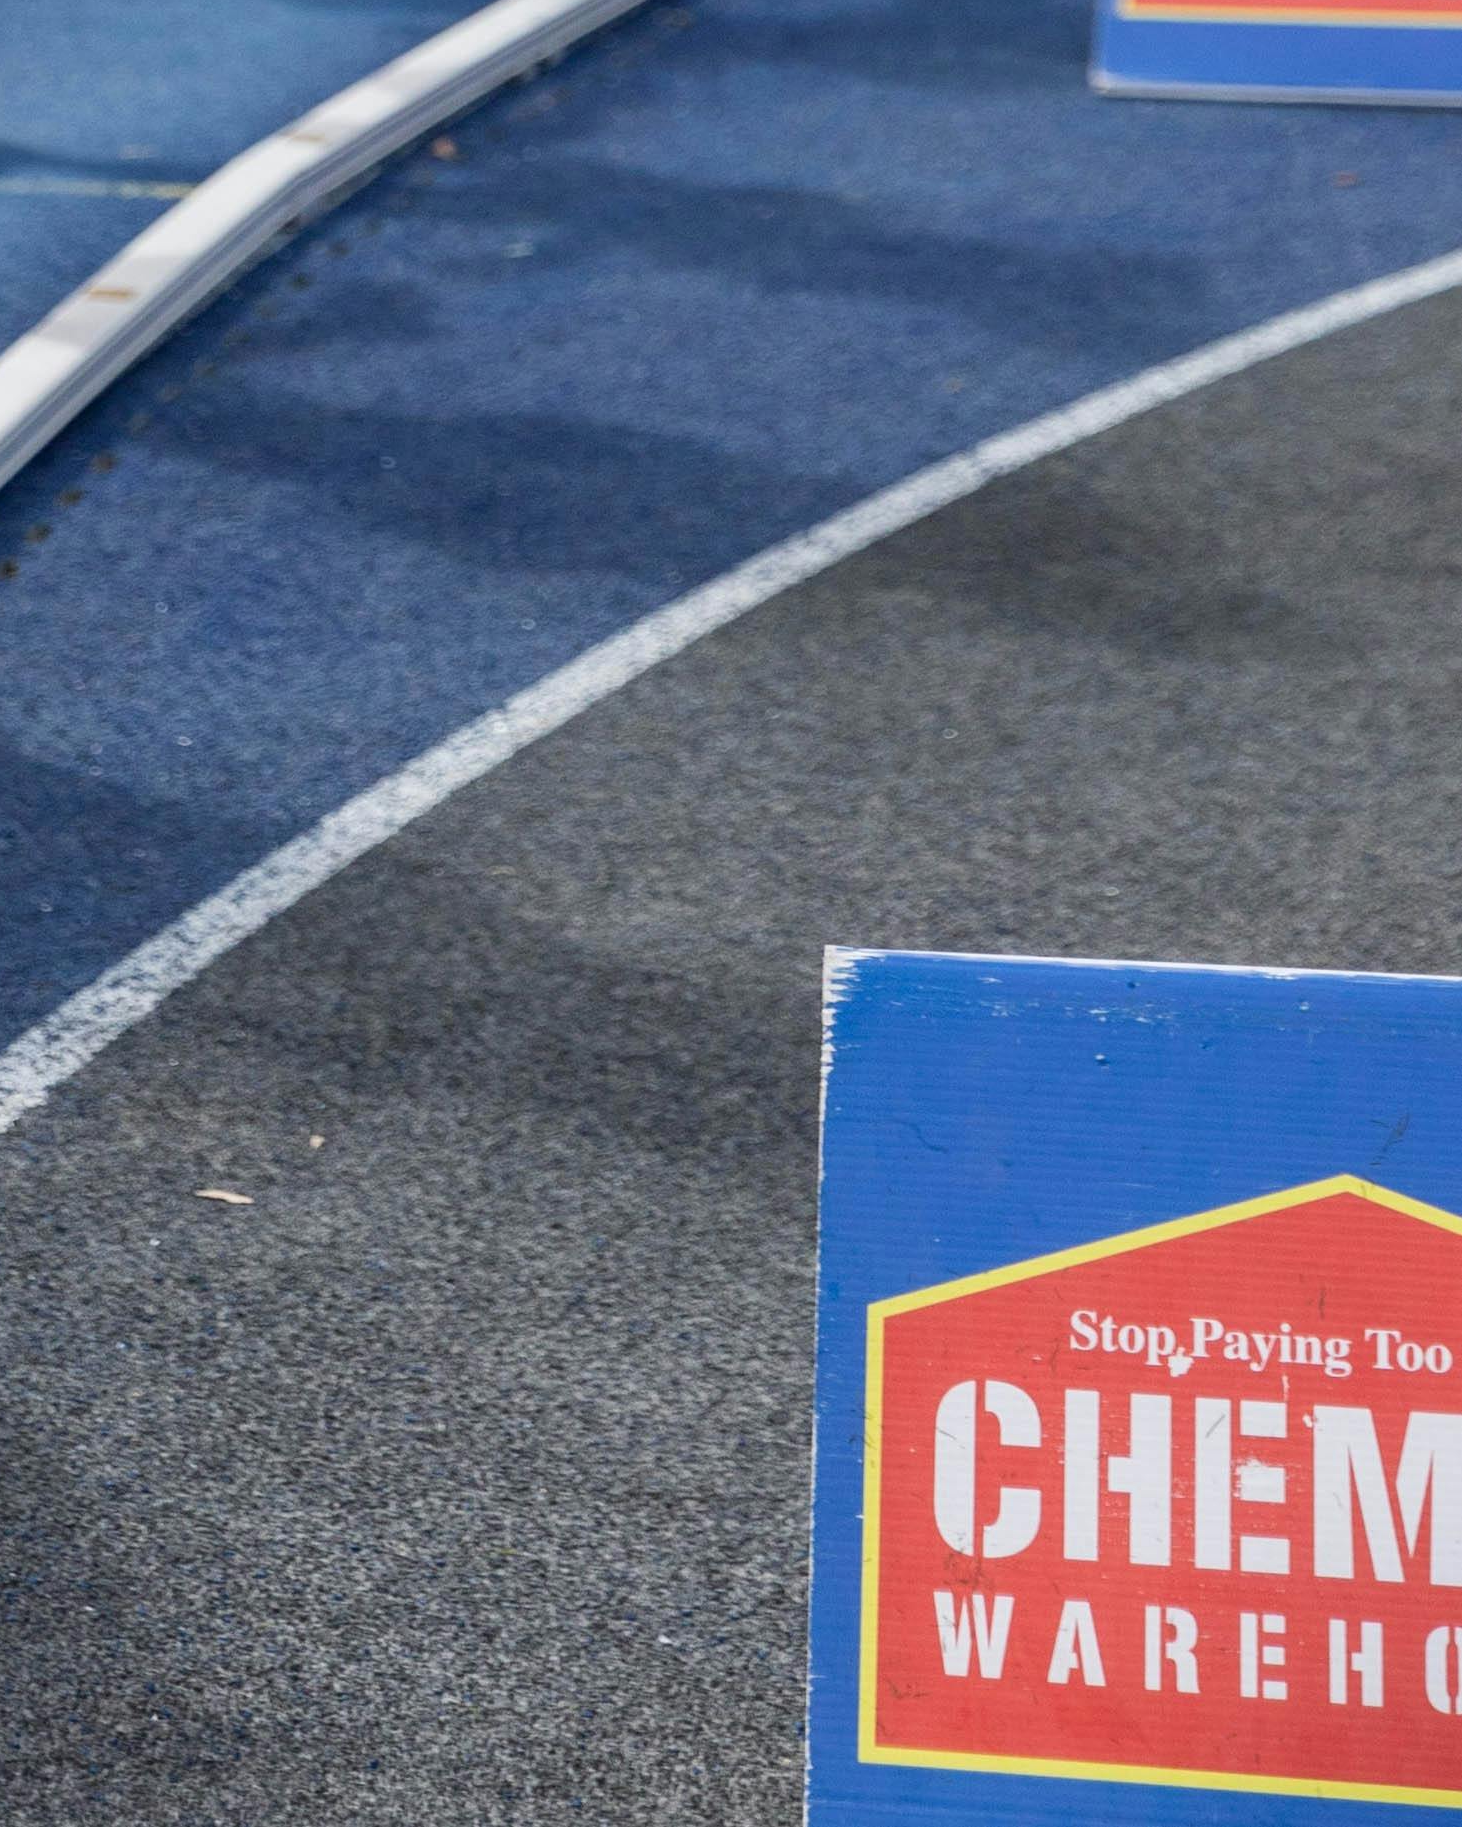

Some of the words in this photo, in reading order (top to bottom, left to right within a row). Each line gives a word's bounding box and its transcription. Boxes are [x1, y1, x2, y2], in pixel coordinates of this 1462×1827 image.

[1070, 1310, 1176, 1366] Stop
[1190, 1317, 1352, 1377] Paying
[1364, 1329, 1453, 1374] Too
[933, 1379, 1462, 1587] CHEM
